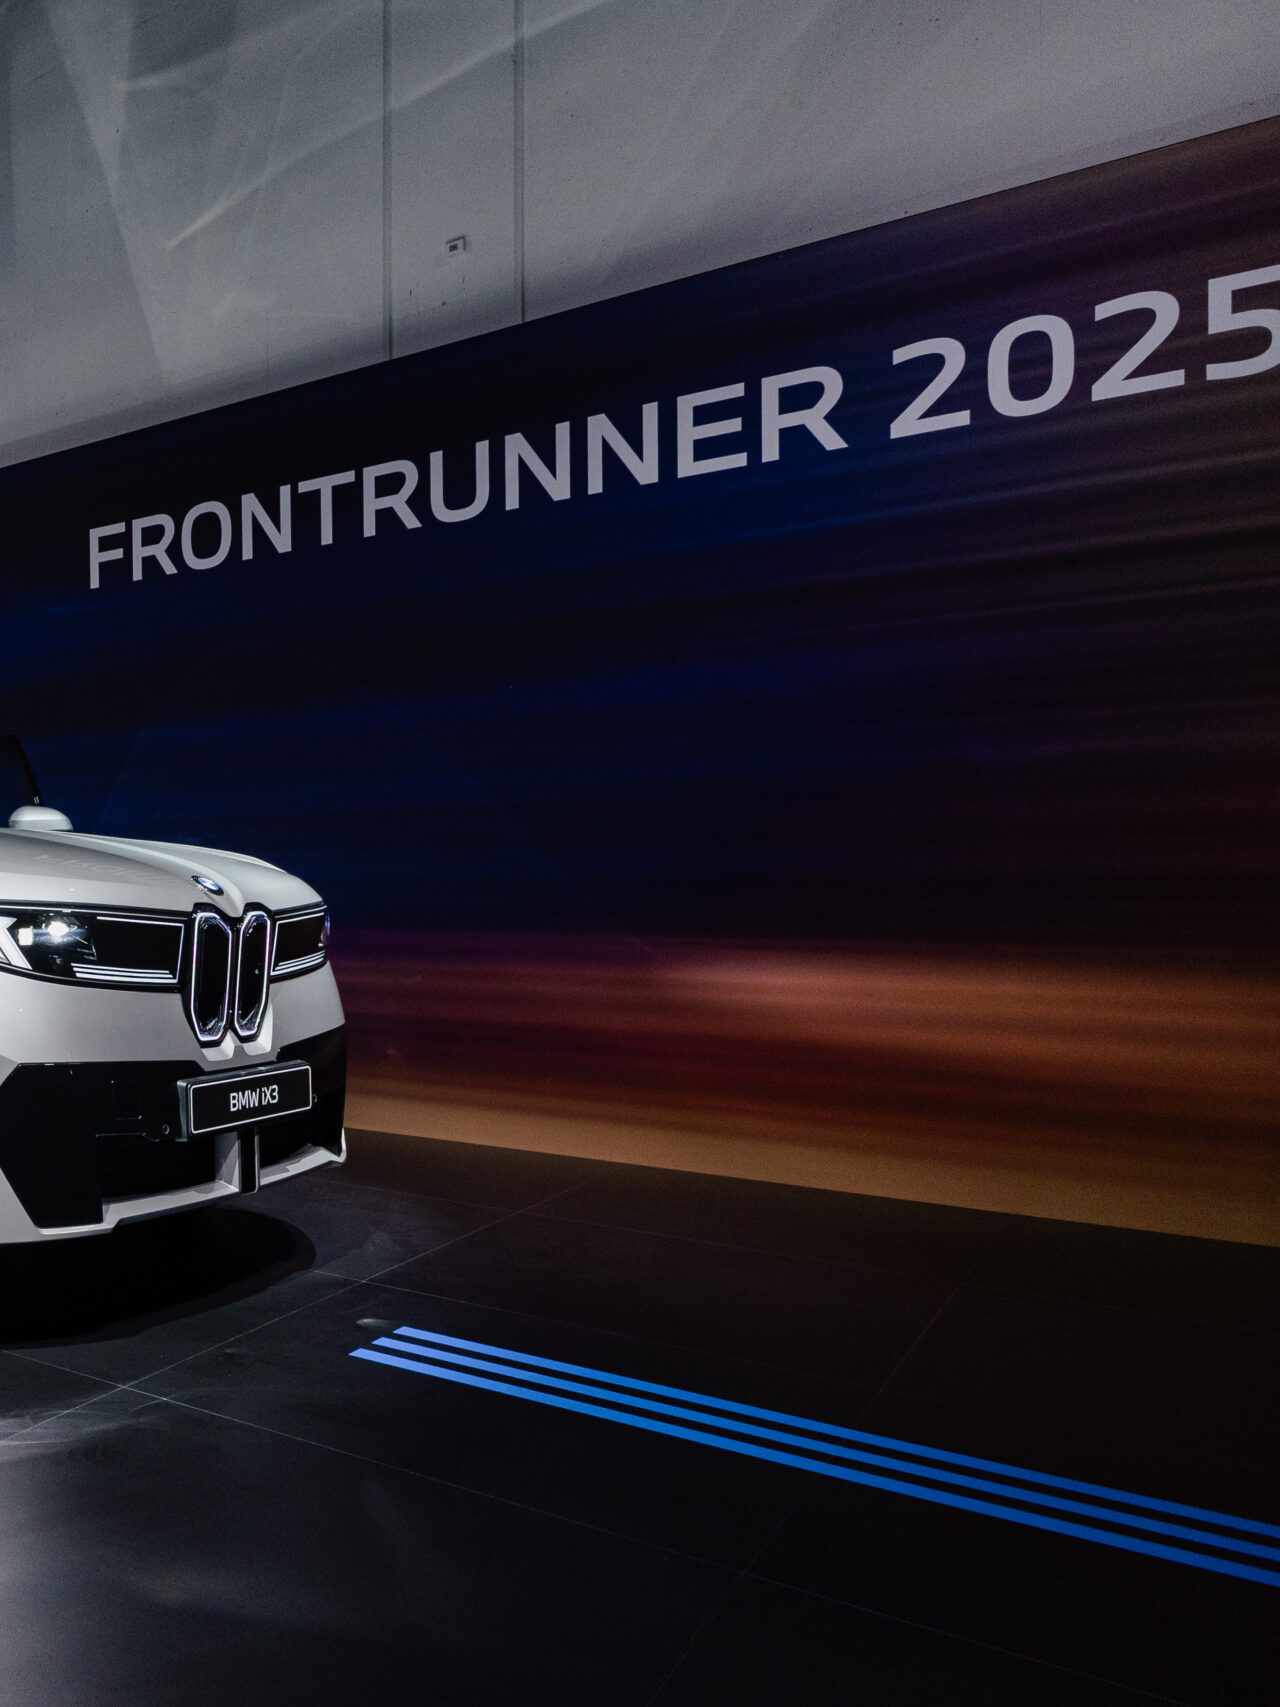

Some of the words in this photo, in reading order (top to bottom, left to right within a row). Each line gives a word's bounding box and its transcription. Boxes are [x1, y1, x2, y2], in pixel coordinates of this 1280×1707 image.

[87, 365, 848, 591] FRONTRUNNER
[889, 266, 1280, 440] 2025
[230, 1088, 260, 1112] BMW
[261, 1084, 278, 1105] iX3
